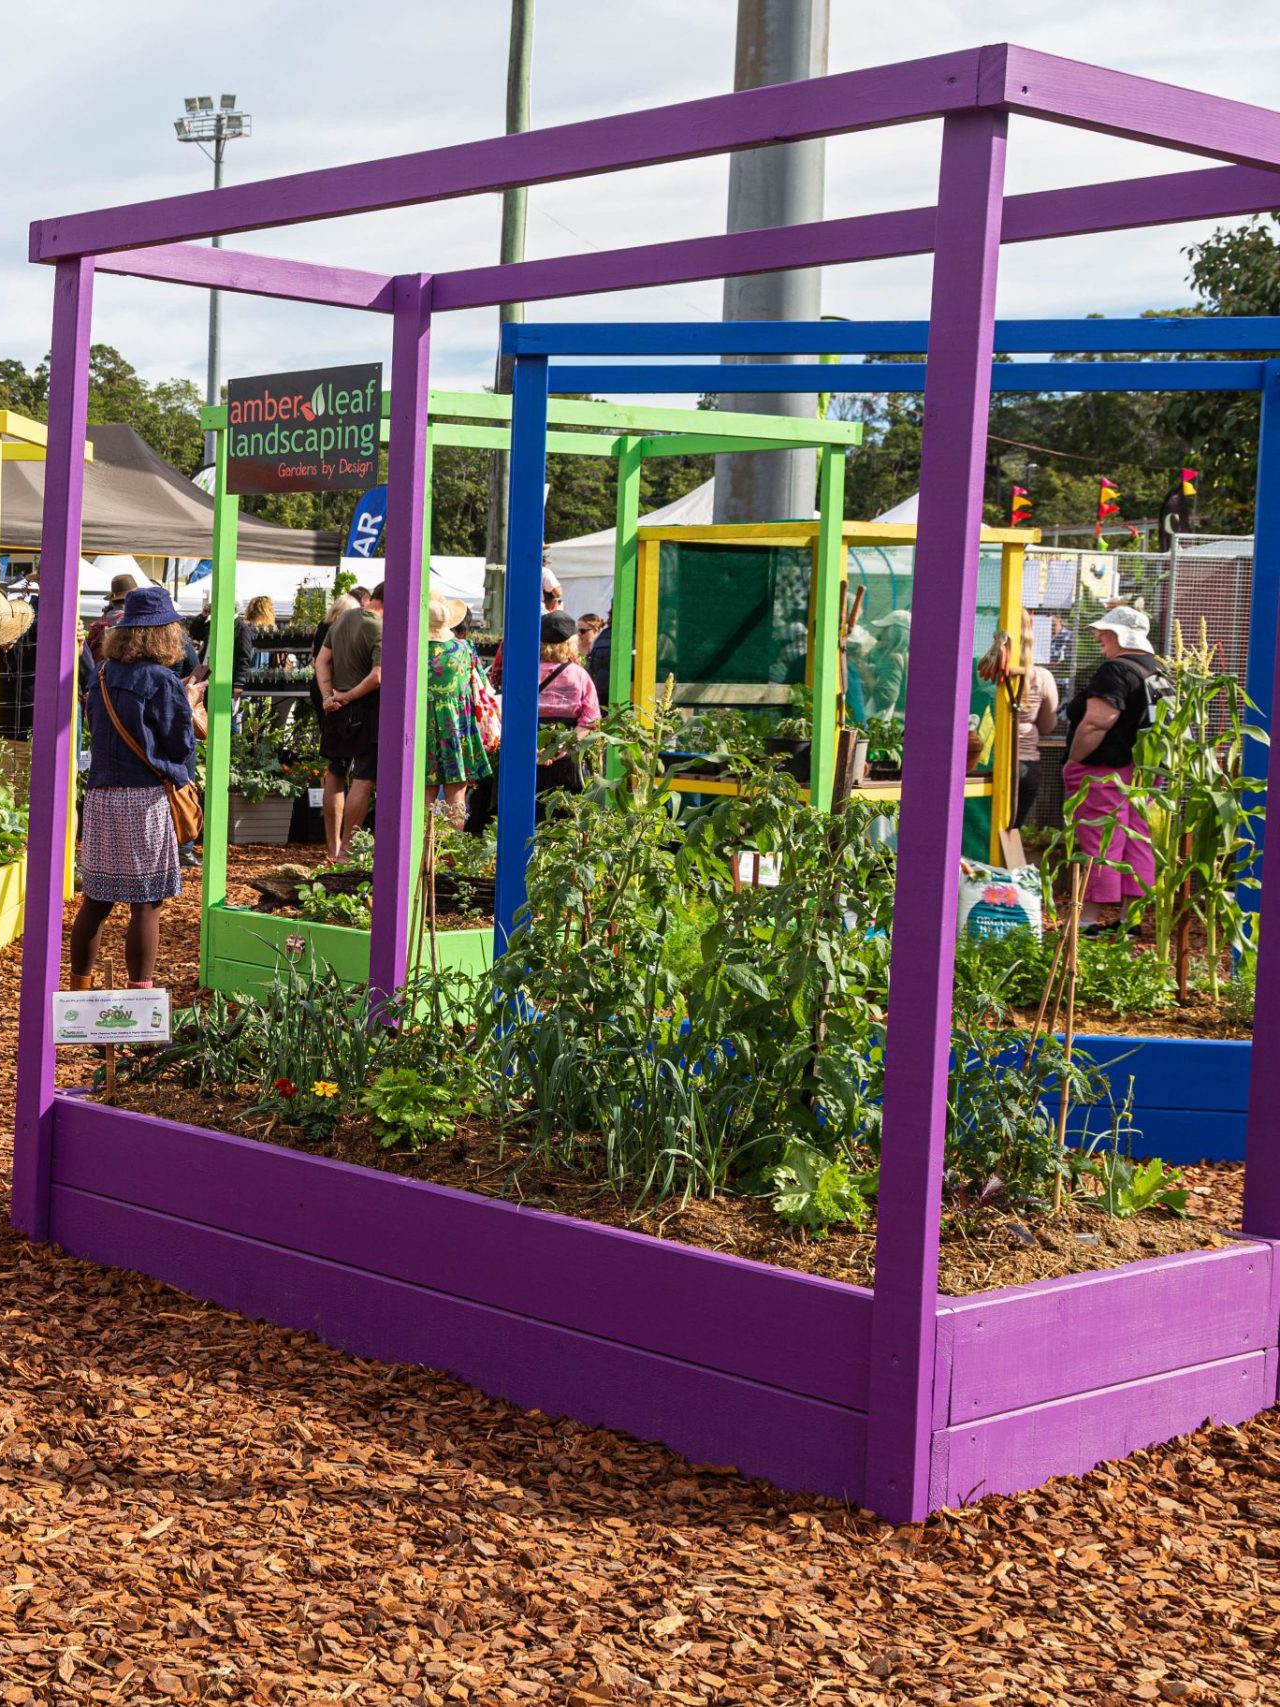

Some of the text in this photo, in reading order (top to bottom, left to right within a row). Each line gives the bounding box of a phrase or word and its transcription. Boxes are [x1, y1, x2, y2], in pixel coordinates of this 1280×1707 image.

[230, 379, 376, 424] amber leaf
[229, 418, 375, 460] landscaping
[278, 458, 373, 480] Gardens by Design
